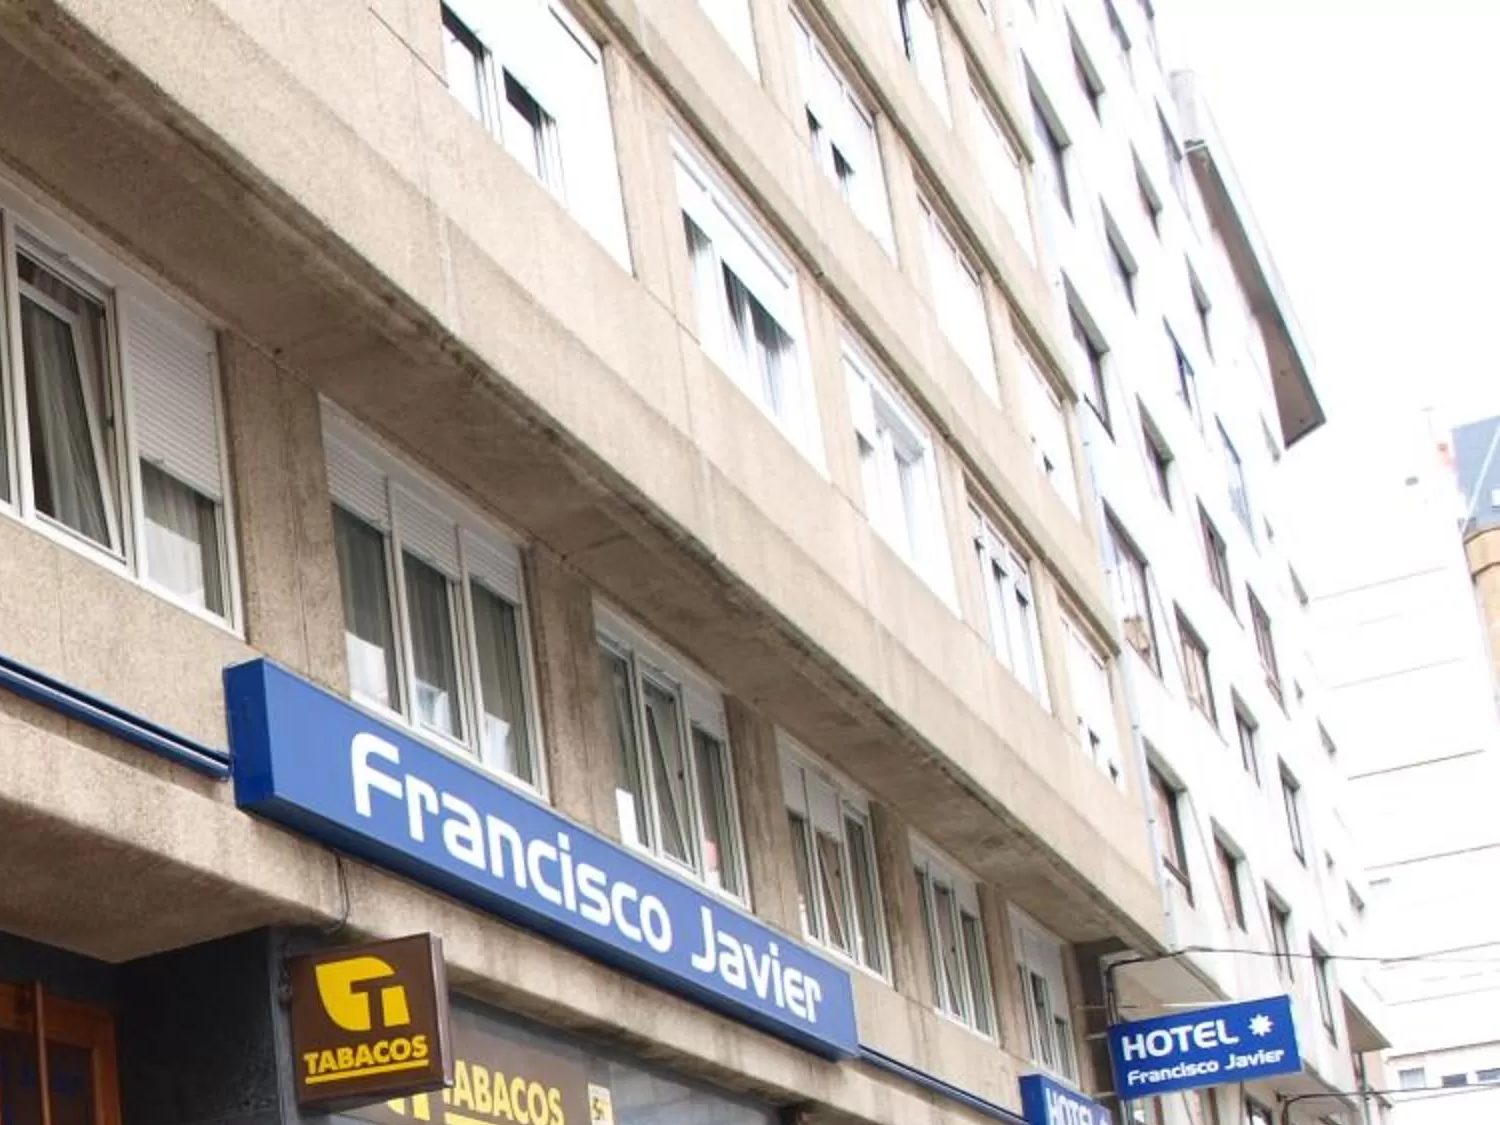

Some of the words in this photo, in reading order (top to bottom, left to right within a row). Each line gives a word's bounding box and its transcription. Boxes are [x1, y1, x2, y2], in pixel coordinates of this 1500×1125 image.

[351, 732, 672, 953] Francisco
[691, 906, 823, 1024] Javier
[303, 1034, 429, 1075] TABACOS
[1121, 1020, 1239, 1061] HOTEL
[1127, 1061, 1219, 1087] Francisco
[1224, 1049, 1285, 1071] Javier
